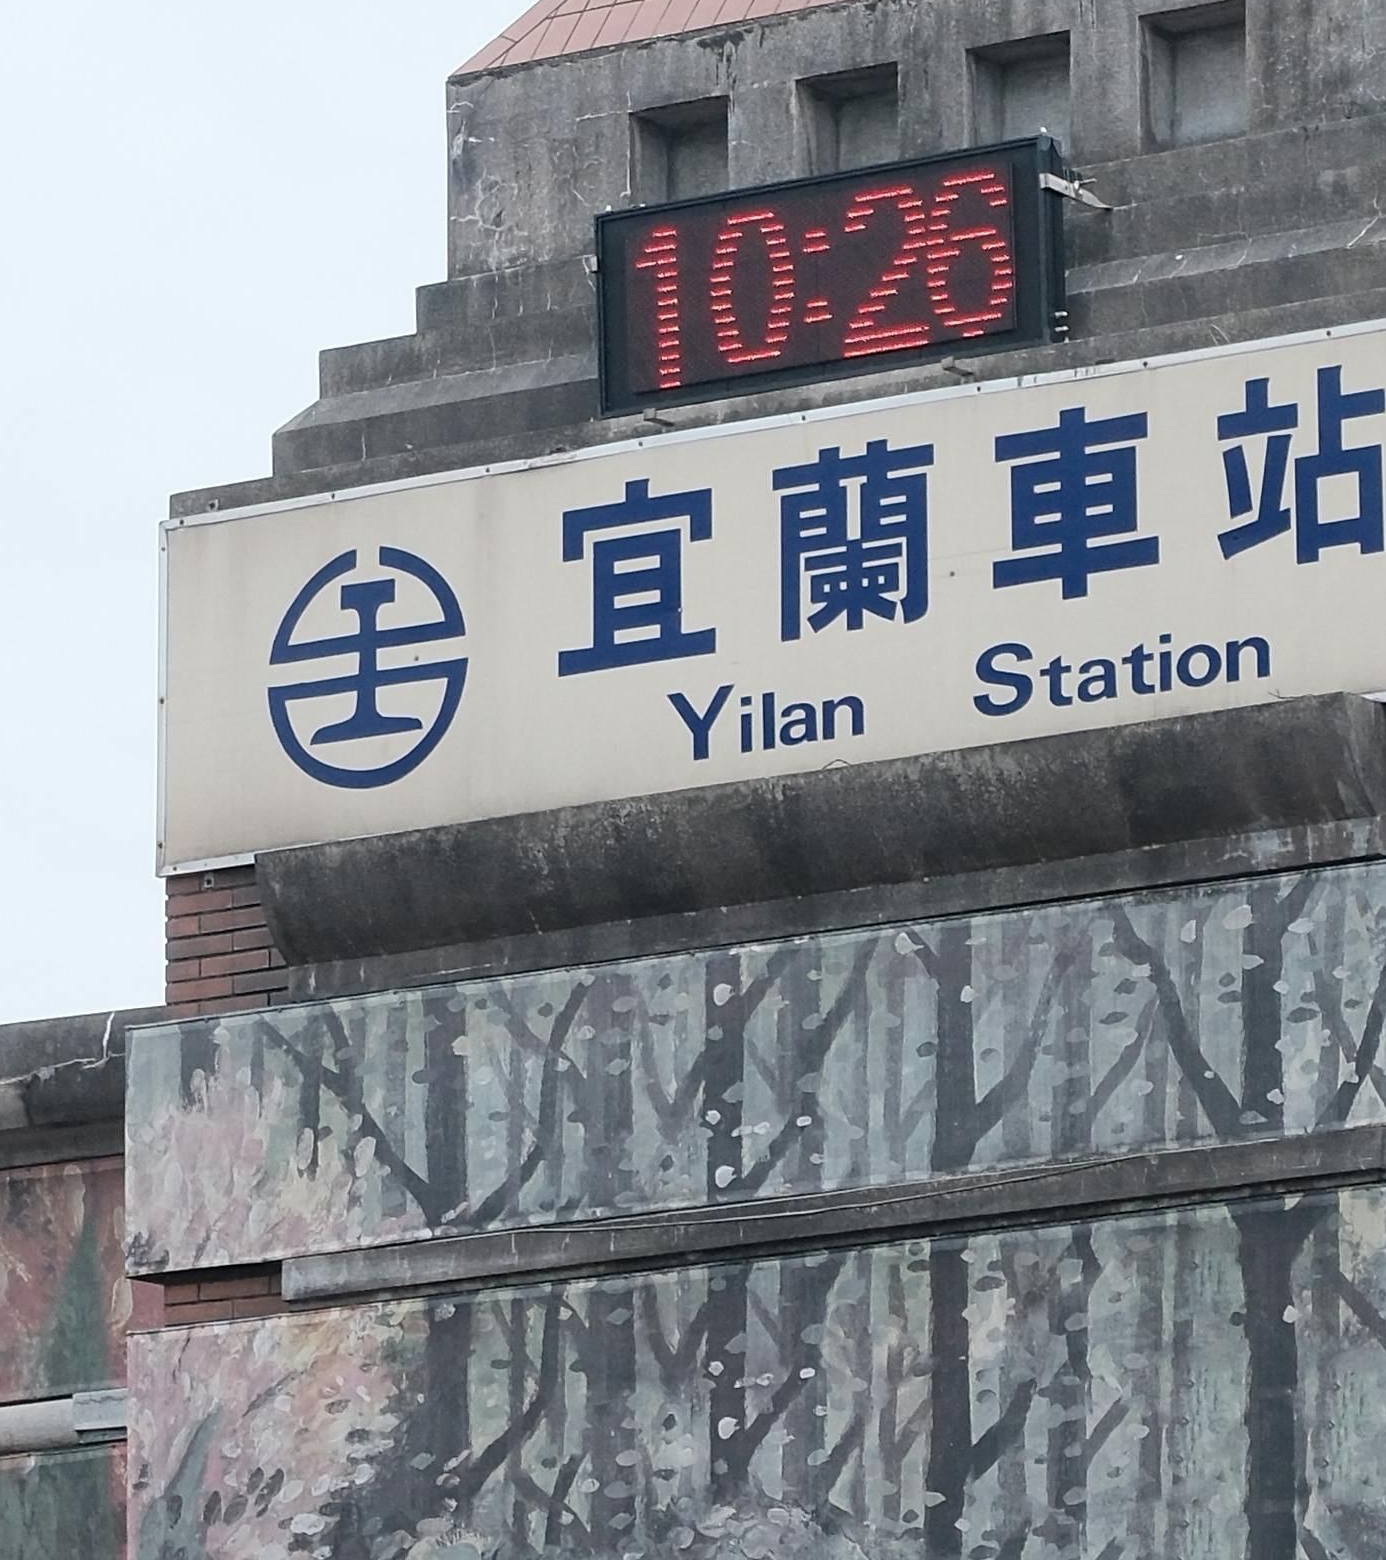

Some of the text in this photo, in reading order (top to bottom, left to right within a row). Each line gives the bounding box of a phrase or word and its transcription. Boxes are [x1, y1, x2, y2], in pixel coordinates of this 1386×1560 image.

[634, 170, 1013, 389] 10:26
[558, 365, 1386, 677] 宜蘭車站
[666, 633, 1272, 761] Yilan Station
